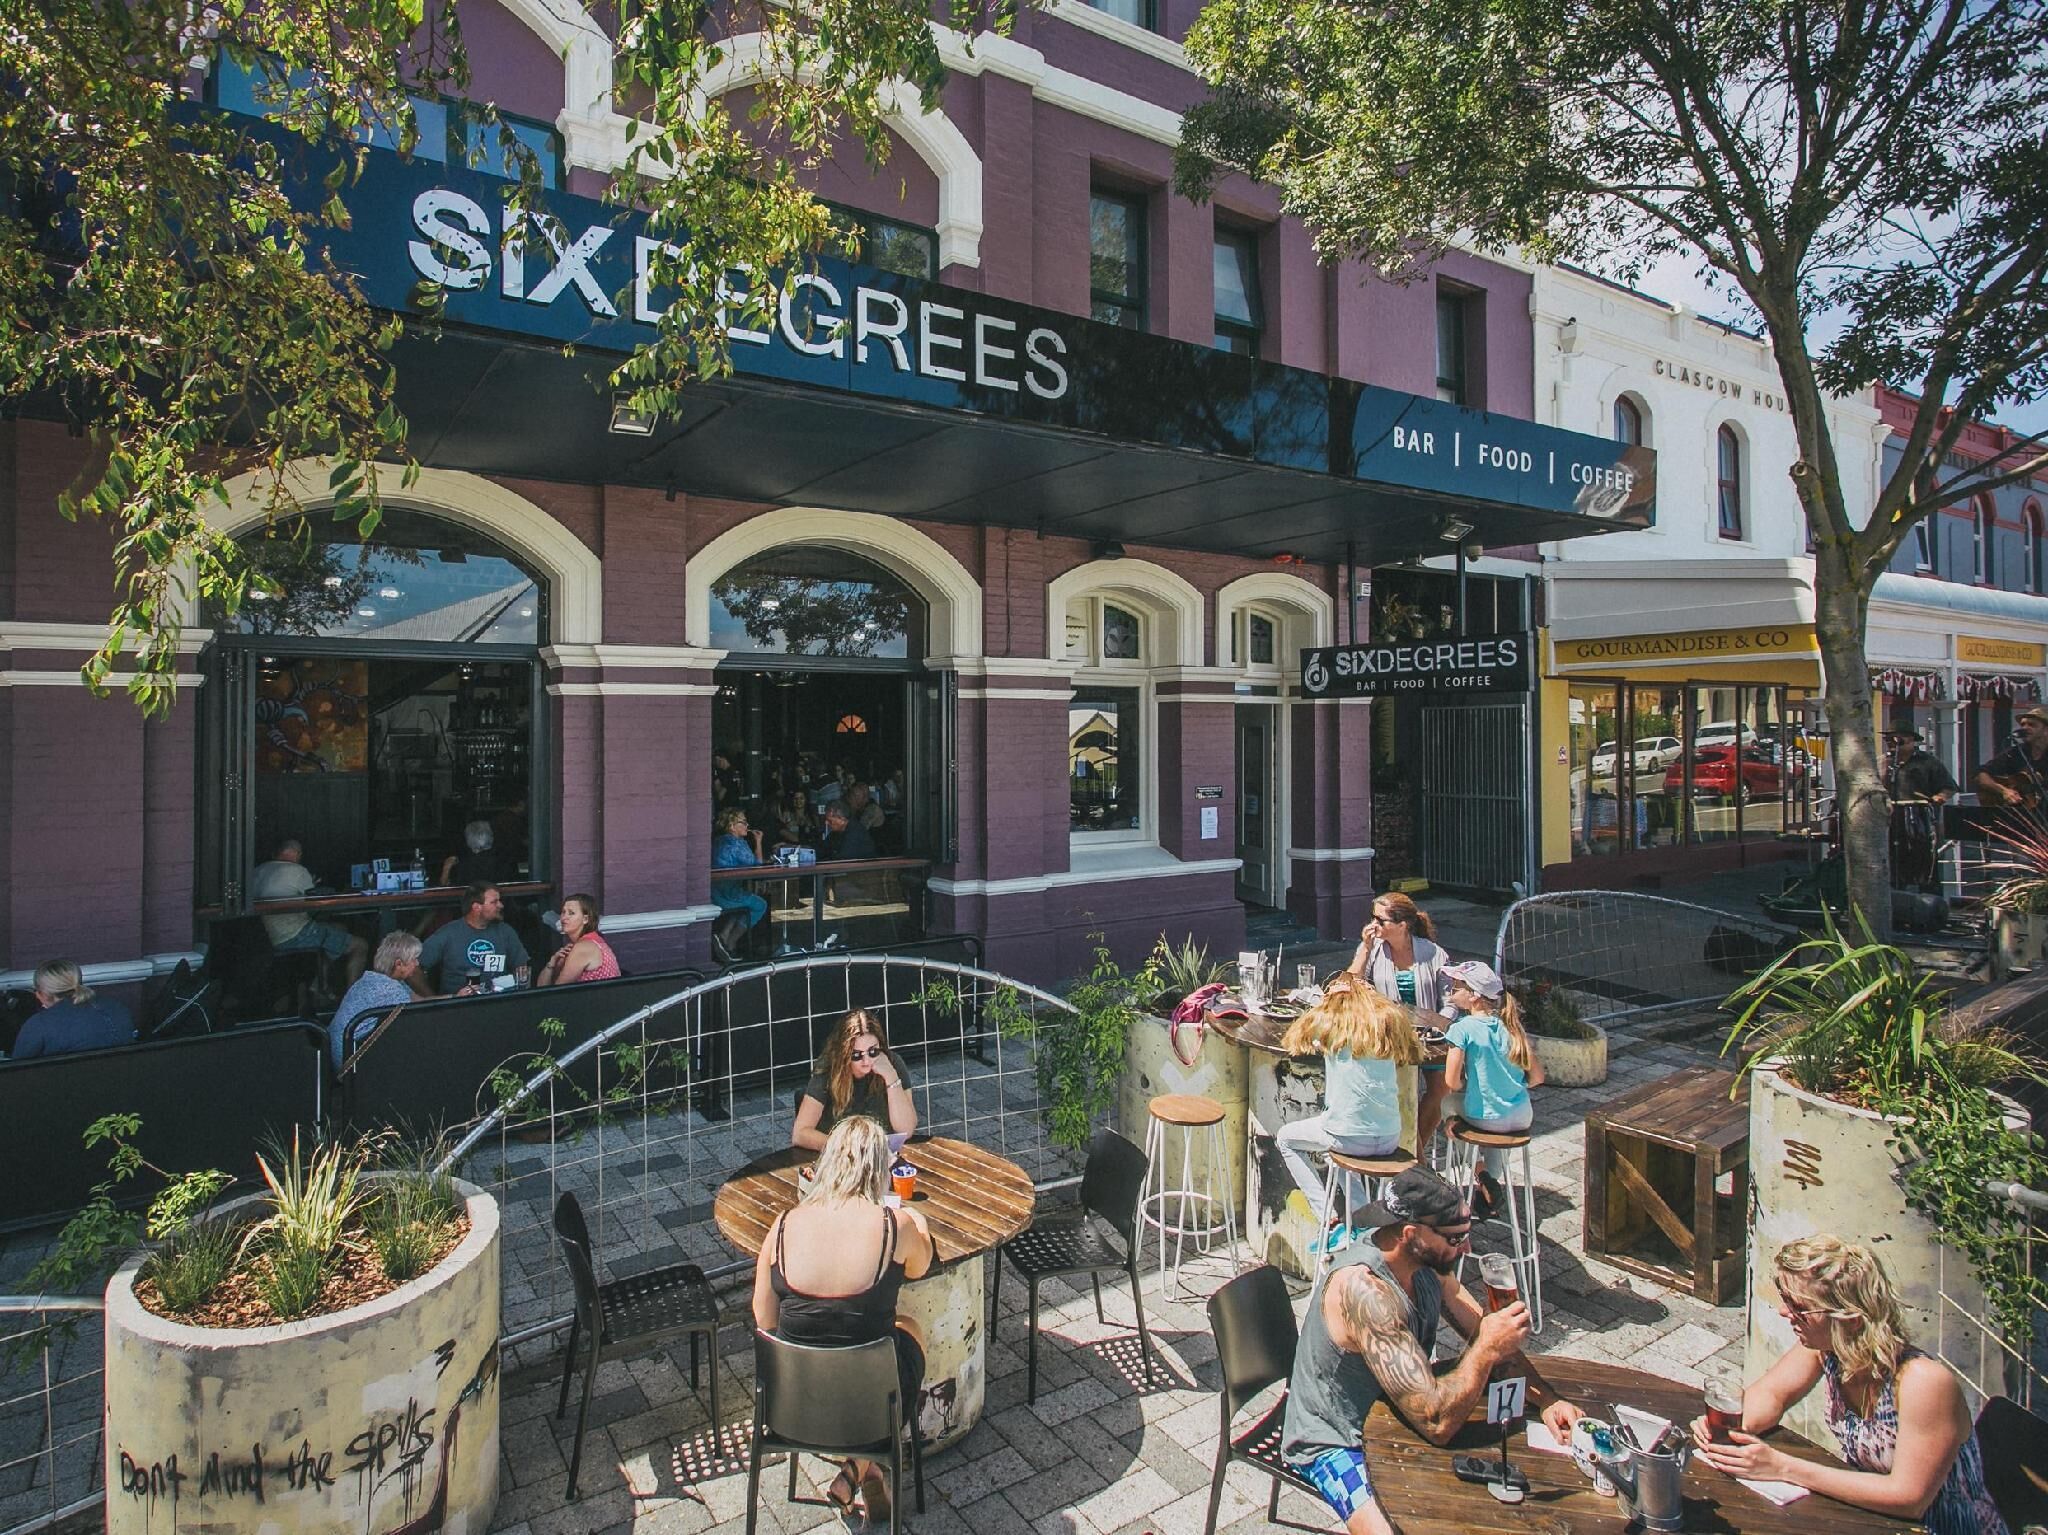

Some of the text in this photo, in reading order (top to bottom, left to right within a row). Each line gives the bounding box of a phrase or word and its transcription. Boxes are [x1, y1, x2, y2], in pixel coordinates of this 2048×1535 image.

[1655, 359, 1785, 413] GLASGOW HOU
[1393, 426, 1634, 492] BAR FOOD COFFEE
[1577, 631, 1789, 658] GOURMANDISE & CO
[1356, 675, 1492, 691] BAR FOOD COFFEE
[1496, 1382, 1518, 1411] 17
[272, 1438, 336, 1492] the
